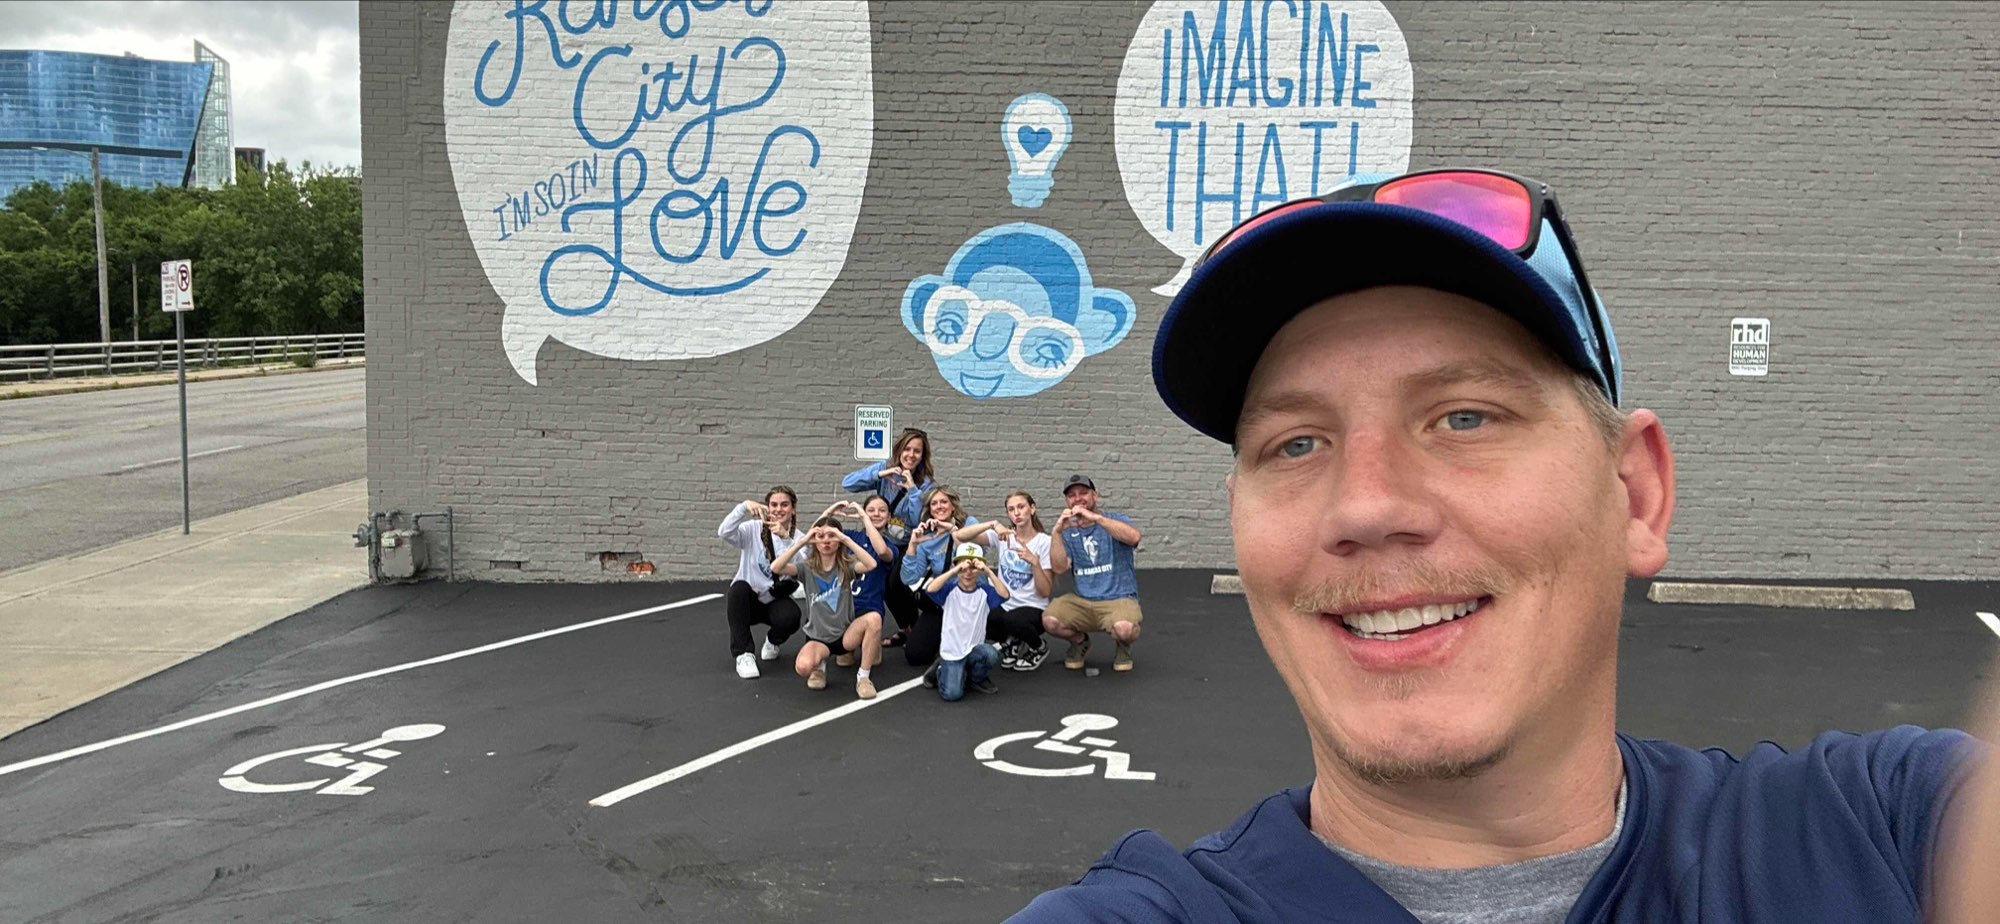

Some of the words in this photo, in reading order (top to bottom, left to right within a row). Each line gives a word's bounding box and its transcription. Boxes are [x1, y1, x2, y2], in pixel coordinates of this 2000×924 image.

[1161, 0, 1380, 108] IMAGINE
[572, 37, 787, 185] City
[1733, 322, 1767, 343] rhd
[1733, 350, 1766, 359] HUMAN
[858, 410, 890, 419] RESERVED
[860, 420, 888, 428] PARKING
